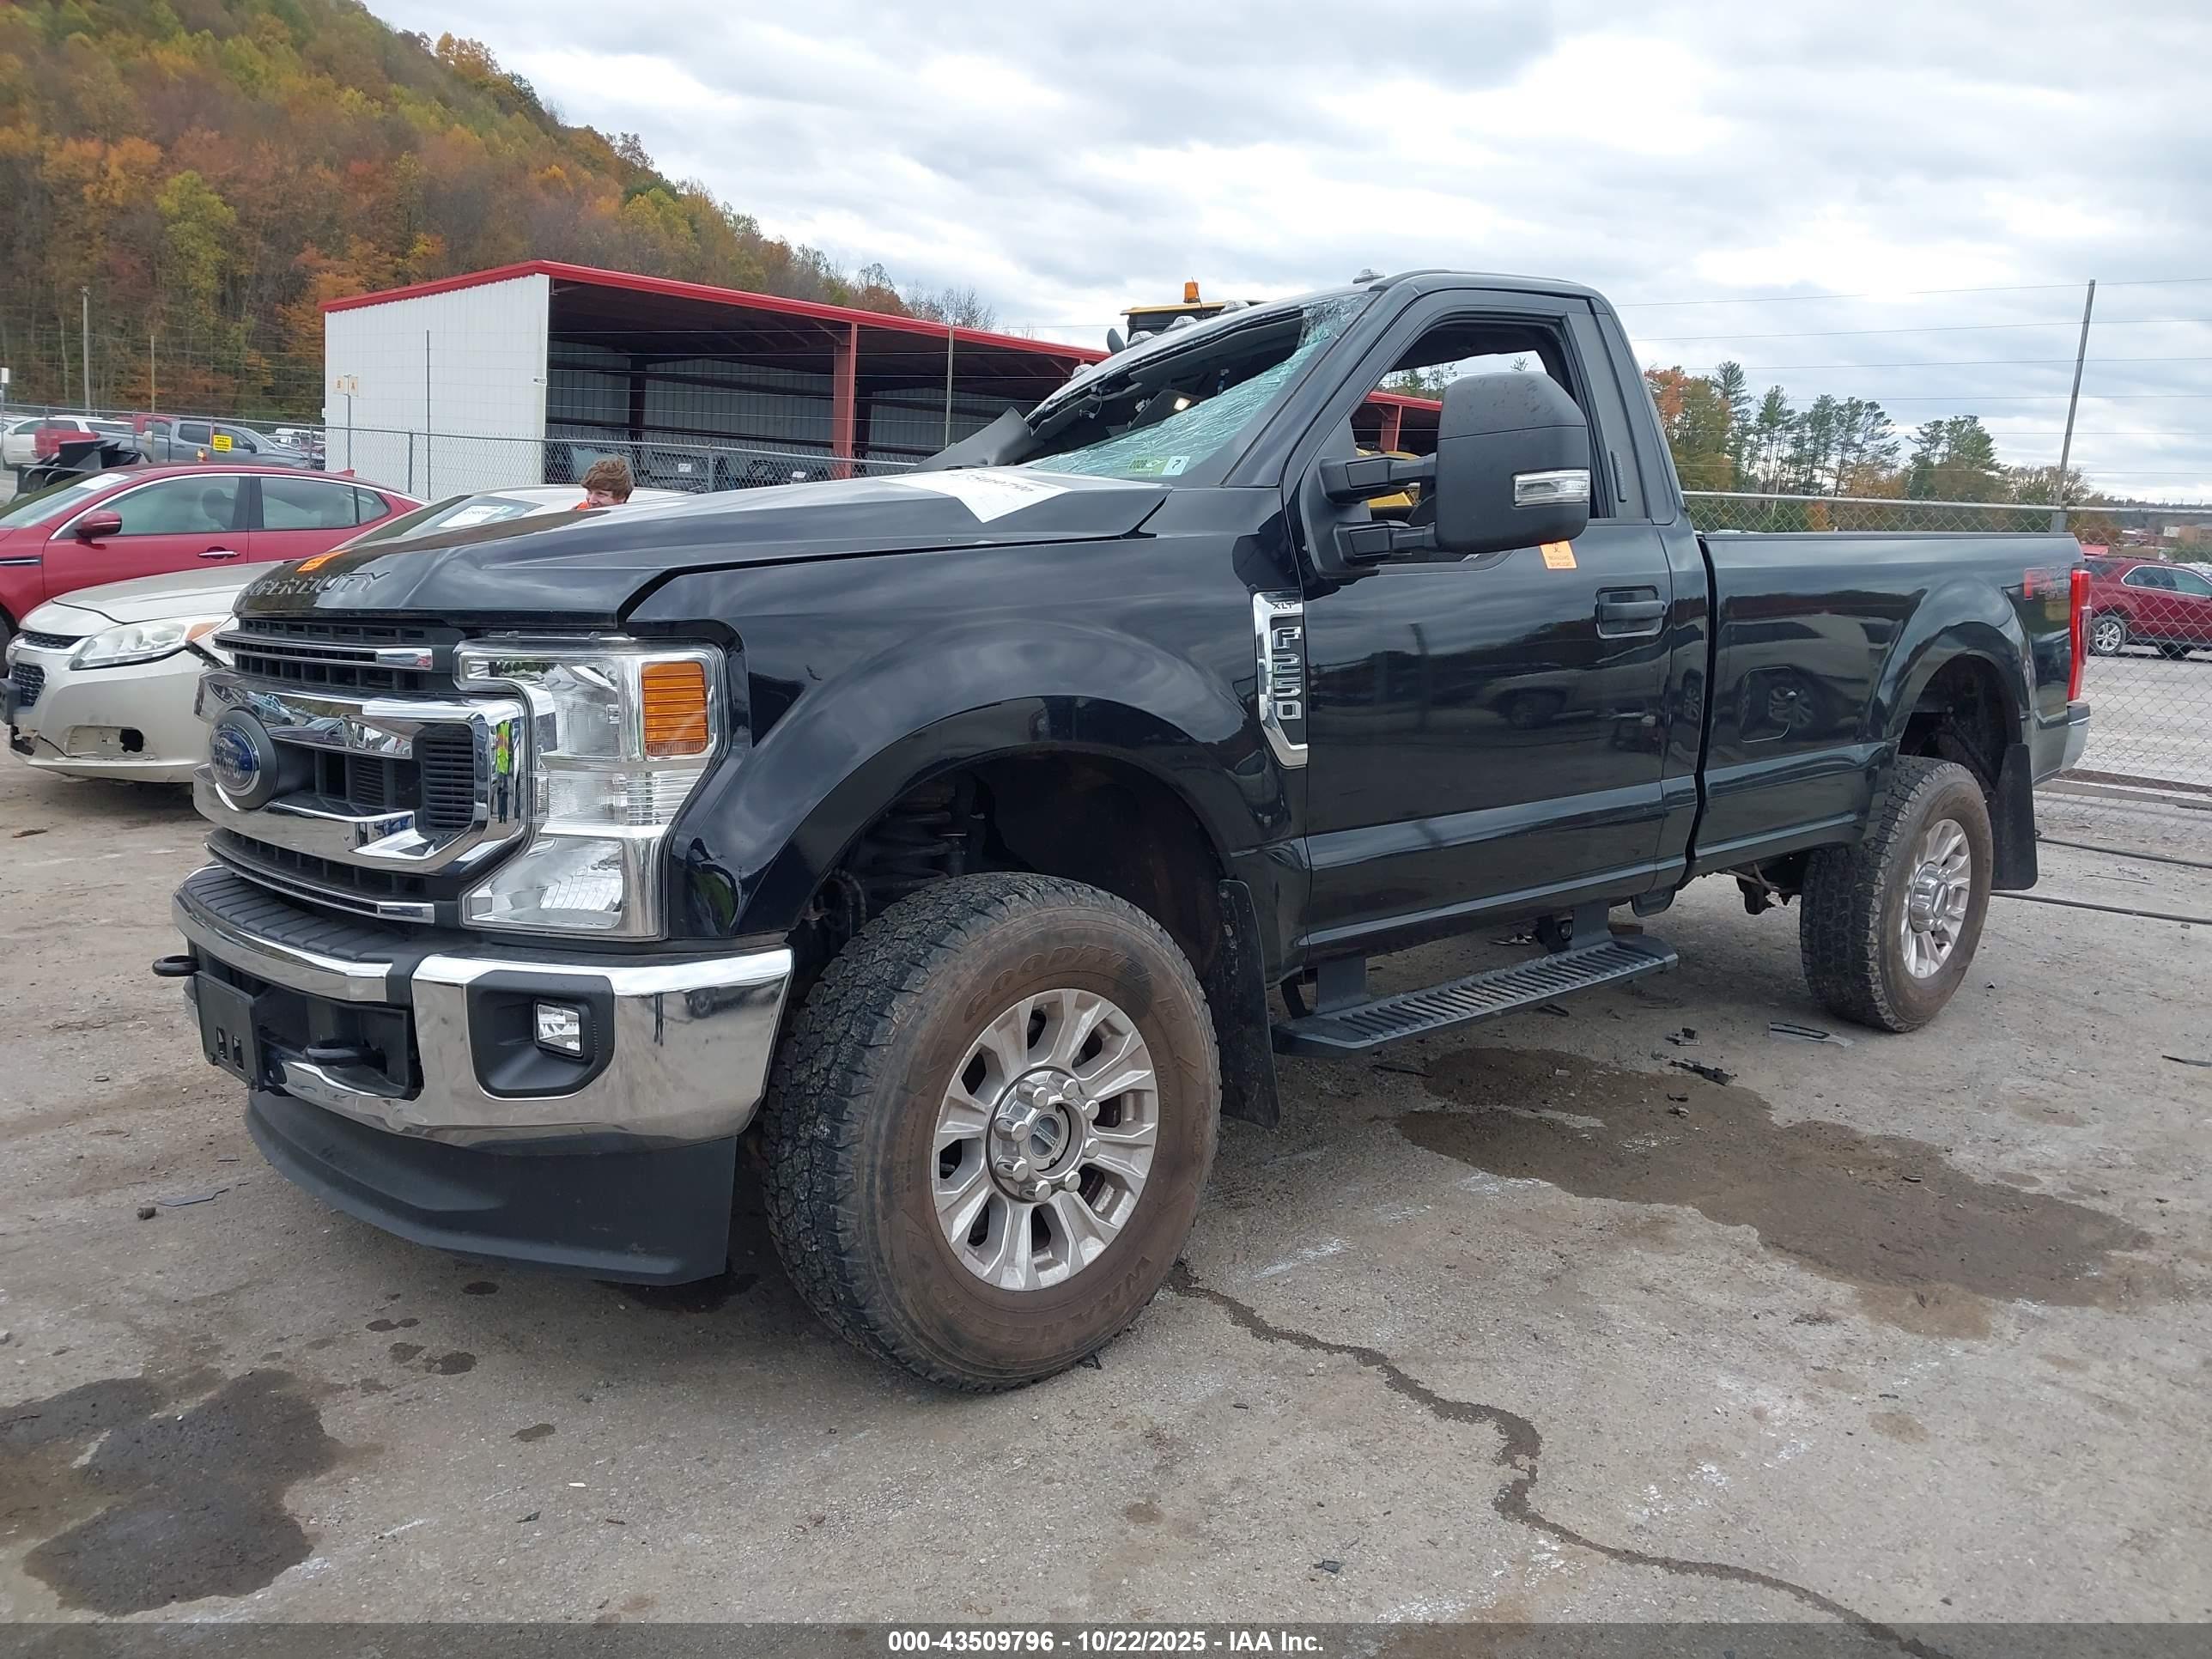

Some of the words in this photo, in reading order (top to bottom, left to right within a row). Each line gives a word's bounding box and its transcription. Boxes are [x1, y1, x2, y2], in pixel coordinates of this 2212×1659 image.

[1171, 459, 1182, 470] 7
[295, 571, 392, 594] DUTY
[2024, 565, 2069, 600] FX4
[1273, 602, 1293, 611] XLT
[1271, 626, 1303, 720] F250
